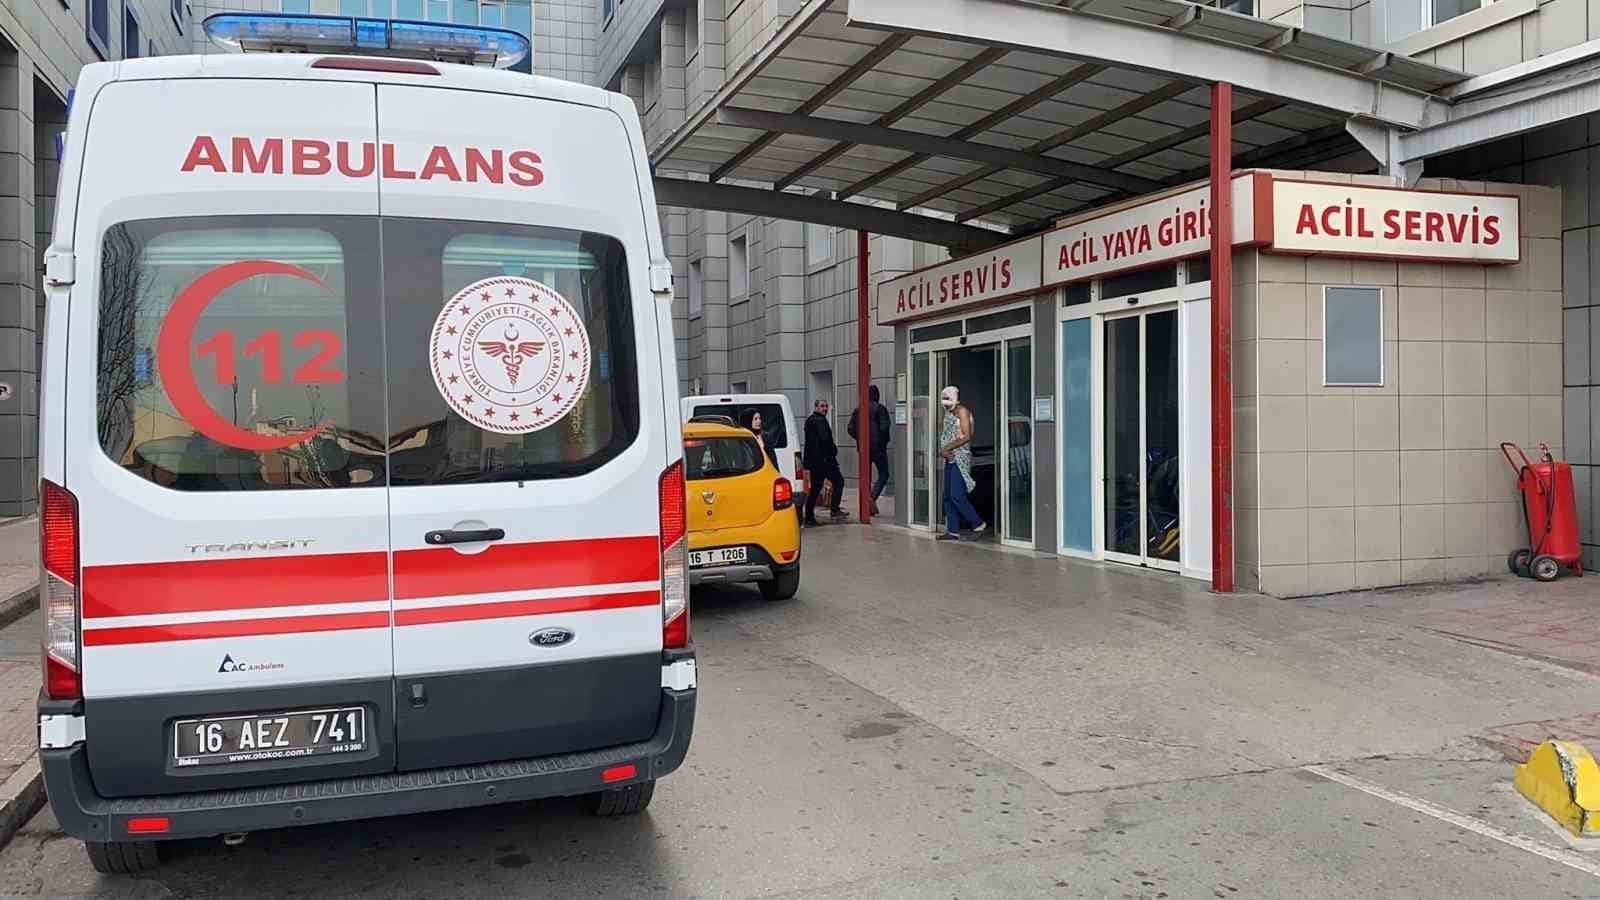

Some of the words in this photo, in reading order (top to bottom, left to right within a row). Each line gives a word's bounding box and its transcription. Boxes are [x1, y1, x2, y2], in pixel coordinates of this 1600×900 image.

[181, 135, 544, 187] AMBULANS
[1058, 232, 1099, 271] ACİL
[1102, 223, 1153, 261] YAYA
[1157, 199, 1212, 247] GİRİ
[1295, 197, 1375, 239] ACİL
[1383, 205, 1500, 246] SERVİS
[896, 277, 934, 314] ACİL
[940, 255, 1011, 303] SERVİS
[197, 328, 346, 385] 112
[184, 539, 318, 553] TRANSIT
[690, 551, 701, 565] 16
[708, 551, 714, 562] T
[721, 548, 745, 561] 1206
[539, 631, 566, 643] Ford
[195, 723, 222, 753] 16
[239, 717, 290, 750] AEZ
[312, 712, 356, 744] 741
